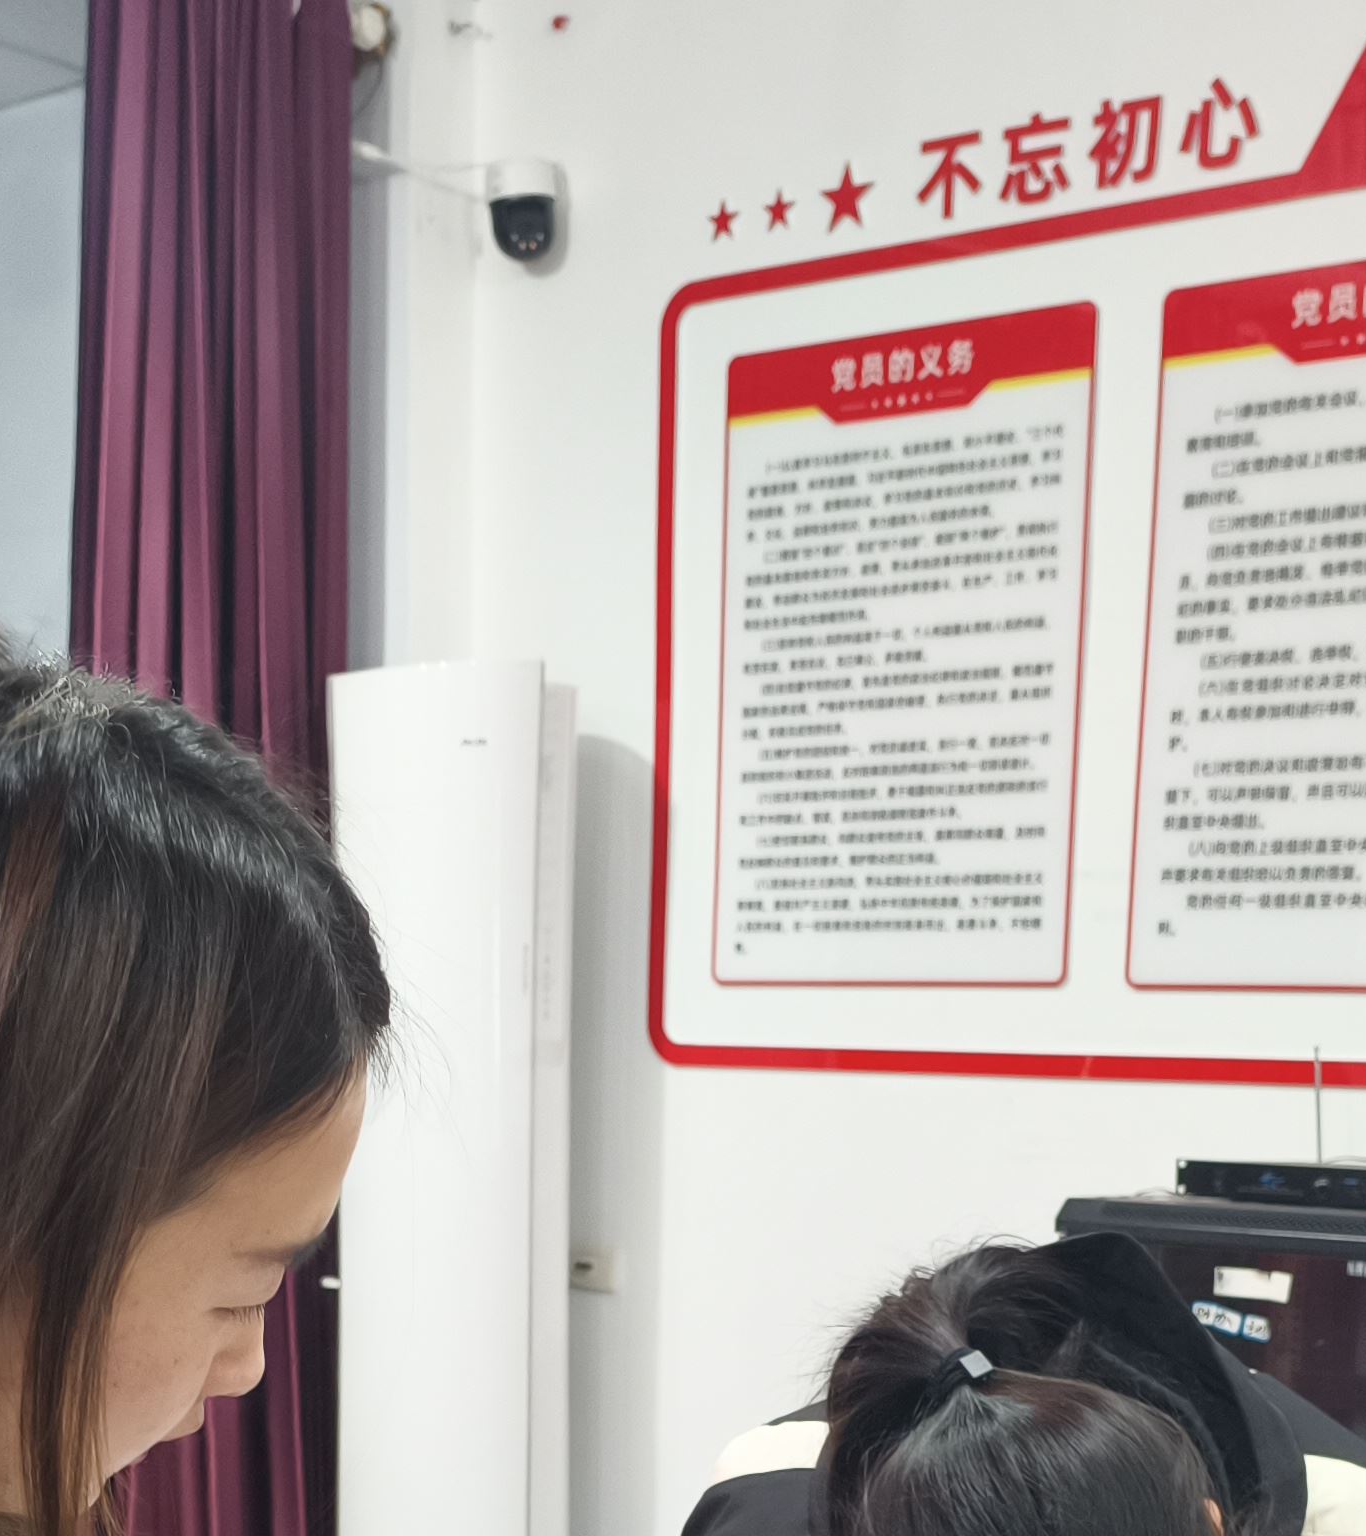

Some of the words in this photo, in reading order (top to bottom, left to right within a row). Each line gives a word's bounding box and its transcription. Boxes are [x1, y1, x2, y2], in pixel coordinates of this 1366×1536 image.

[916, 77, 1260, 221] 不忘初心
[830, 338, 977, 394] 党员的义务
